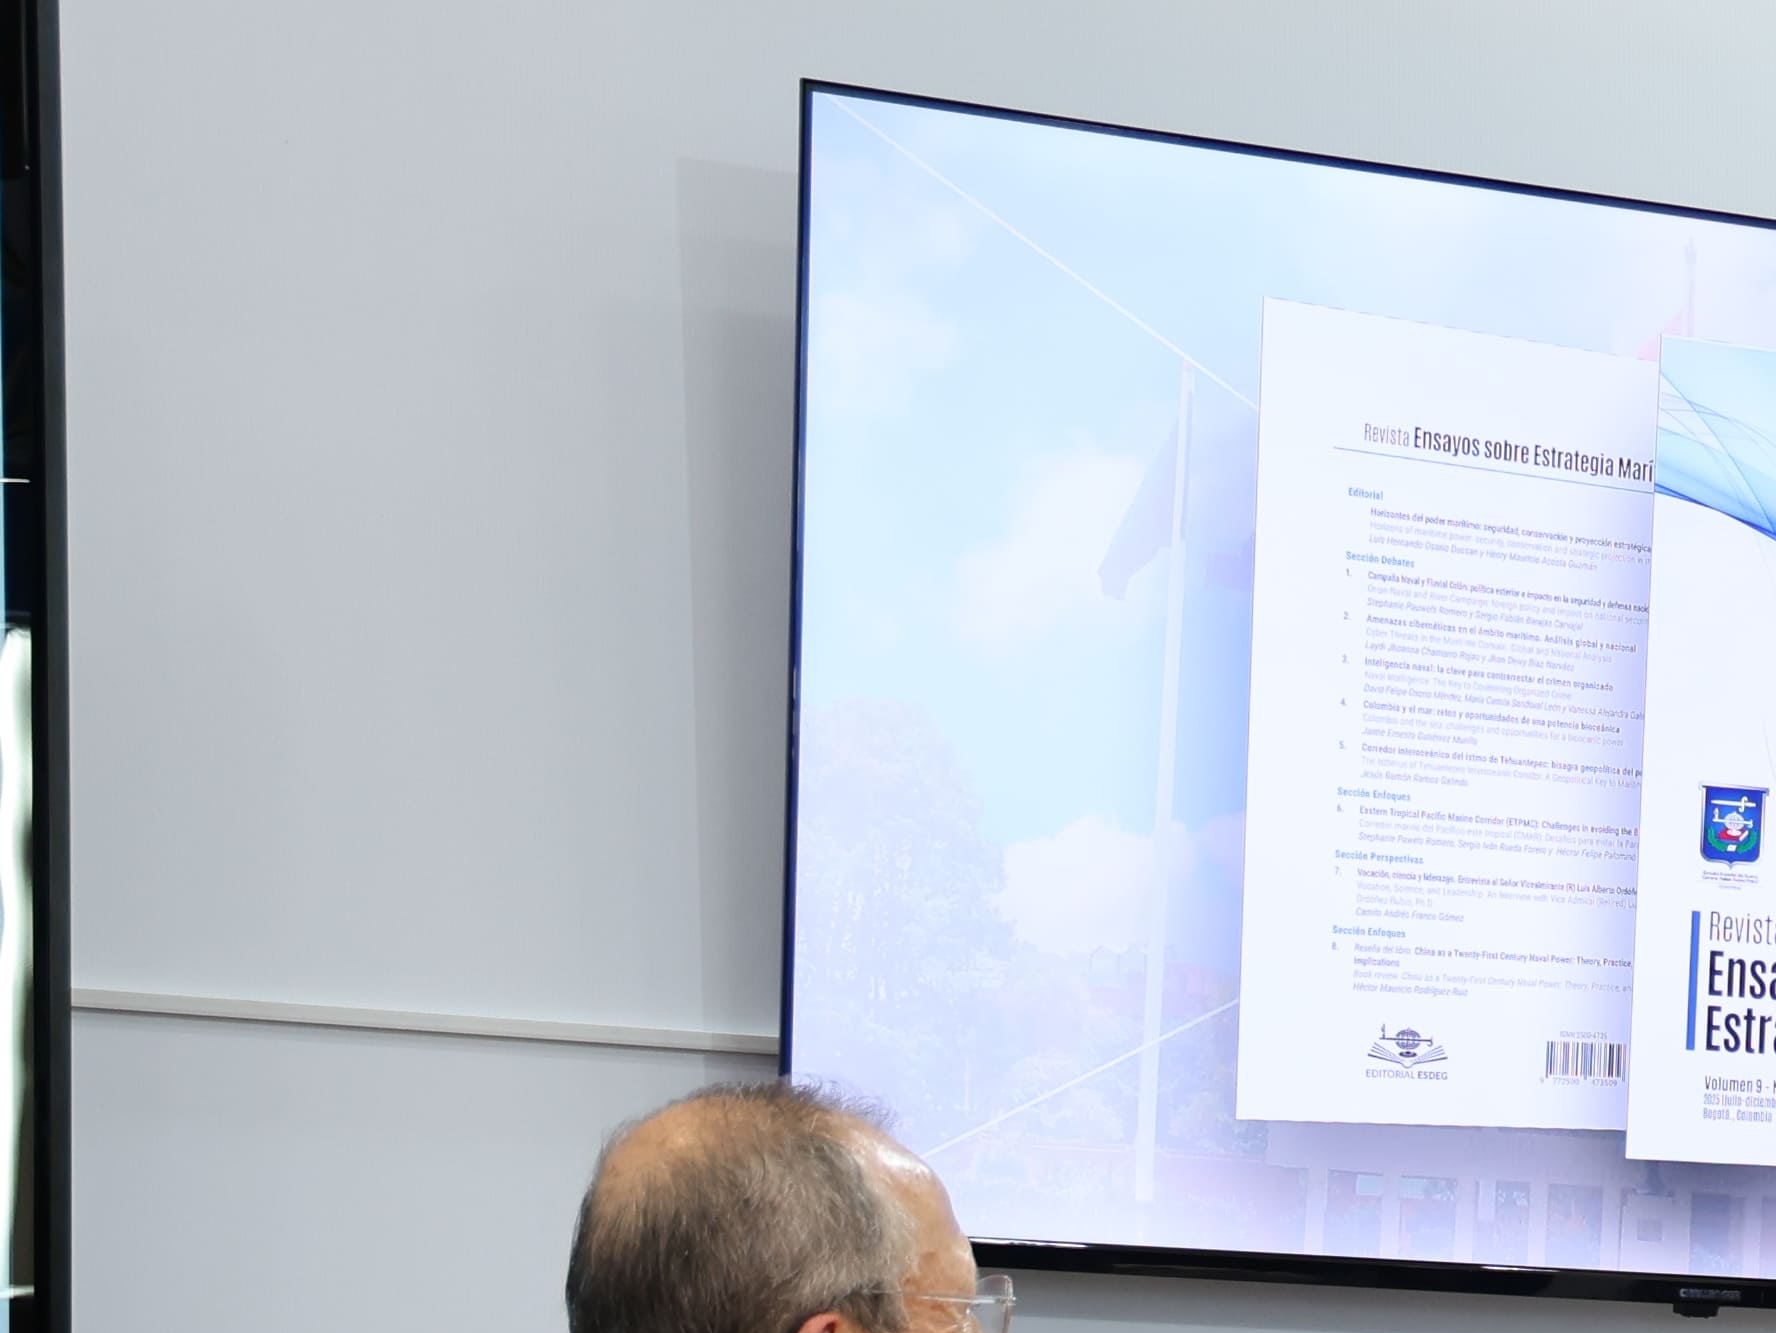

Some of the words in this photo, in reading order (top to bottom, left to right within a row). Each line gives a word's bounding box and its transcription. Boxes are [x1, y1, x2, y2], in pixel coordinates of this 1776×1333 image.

[1364, 422, 1410, 447] Revista
[1414, 426, 1480, 458] Ensayos
[1484, 439, 1529, 465] sobre
[1534, 444, 1614, 476] Estrategia
[1348, 487, 1384, 500] Editorial
[1370, 508, 1410, 521] Horizontes
[1412, 513, 1424, 523] del
[1424, 515, 1446, 527] poder
[1484, 522, 1520, 537] seguridad,
[1521, 527, 1568, 542] conservación
[1574, 534, 1612, 549] proyección
[1346, 551, 1378, 564] Sección
[1381, 556, 1415, 568] Debates
[1367, 614, 1407, 627] Amenazas
[1408, 619, 1456, 633] cibernéticas
[1458, 626, 1468, 634] en
[1469, 626, 1477, 635] el
[1478, 627, 1504, 638] ámbito
[1544, 634, 1573, 646] Análisis
[1575, 638, 1598, 650] global
[1605, 641, 1636, 653] nacional
[1364, 657, 1410, 672] Inteligencia
[1436, 664, 1444, 674] la
[1446, 665, 1466, 676] clave
[1467, 669, 1485, 679] para
[1486, 670, 1535, 683] contrarrestar
[1537, 675, 1544, 684] el
[1546, 676, 1571, 687] crimen
[1573, 679, 1614, 693] organizado
[1363, 700, 1400, 712] Colombia
[1408, 704, 1416, 714] el
[1436, 707, 1456, 718] retos
[1464, 709, 1518, 725] oportunidades
[1520, 715, 1530, 725] de
[1532, 718, 1546, 726] una
[1547, 717, 1579, 731] potencia
[1580, 721, 1620, 733] bioceánica
[1337, 786, 1370, 798] Sección
[1372, 790, 1411, 803] Enfoques
[1359, 806, 1388, 817] Eastern
[1390, 808, 1420, 821] Tropical
[1421, 810, 1446, 821] Pacific
[1448, 812, 1473, 823] Marine
[1474, 814, 1504, 826] Corridor
[1542, 820, 1580, 833] Challenges
[1582, 823, 1588, 832] in
[1590, 823, 1620, 836] avoiding
[1621, 826, 1632, 836] the
[1335, 849, 1368, 860] Sección
[1370, 852, 1424, 864] Perspectivas
[1332, 924, 1366, 936] Sección
[1368, 927, 1406, 940] Enfoques
[1354, 942, 1381, 953] Reseña
[1414, 946, 1436, 956] China
[1437, 949, 1446, 957] as
[1454, 948, 1498, 961] Twenty-First
[1500, 951, 1527, 963] Century
[1529, 953, 1550, 962] Naval
[1576, 955, 1602, 967] Theory,
[1354, 956, 1400, 968] Implications
[1366, 1069, 1416, 1080] EDITORIAL
[1417, 1070, 1448, 1082] ESDEG
[1704, 1076, 1753, 1092] Volumen
[1756, 1079, 1762, 1094] 9
